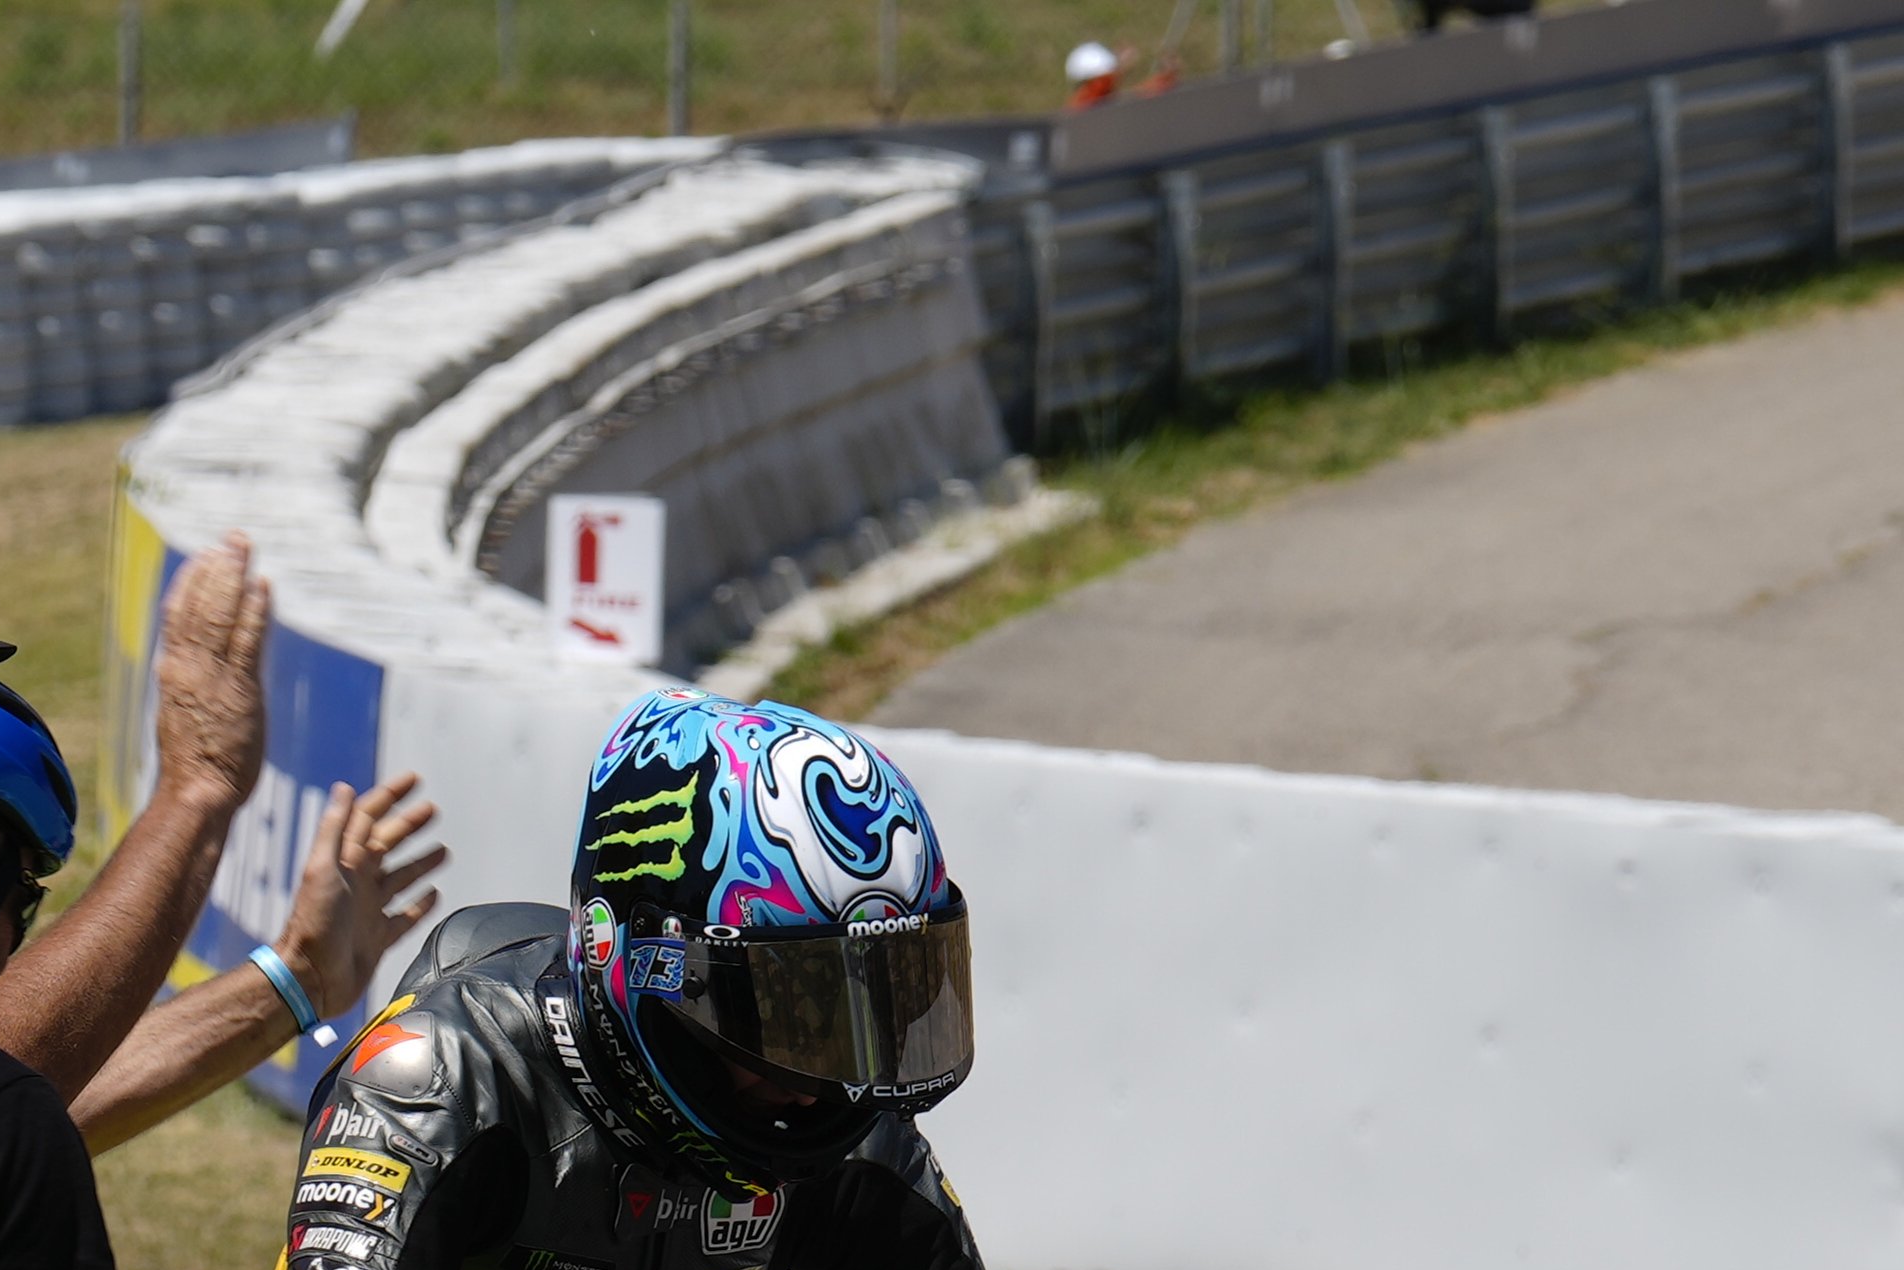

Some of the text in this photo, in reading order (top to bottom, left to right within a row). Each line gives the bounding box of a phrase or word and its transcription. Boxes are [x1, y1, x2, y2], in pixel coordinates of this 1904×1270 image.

[846, 914, 929, 938] mooney
[695, 936, 750, 948] OAKLEY
[629, 945, 686, 992] 13
[545, 996, 646, 1147] DAINESE
[872, 1072, 956, 1097] CUPRA
[320, 1155, 401, 1178] DUNLOP
[296, 1181, 395, 1221] mooney
[710, 1217, 769, 1250] agv
